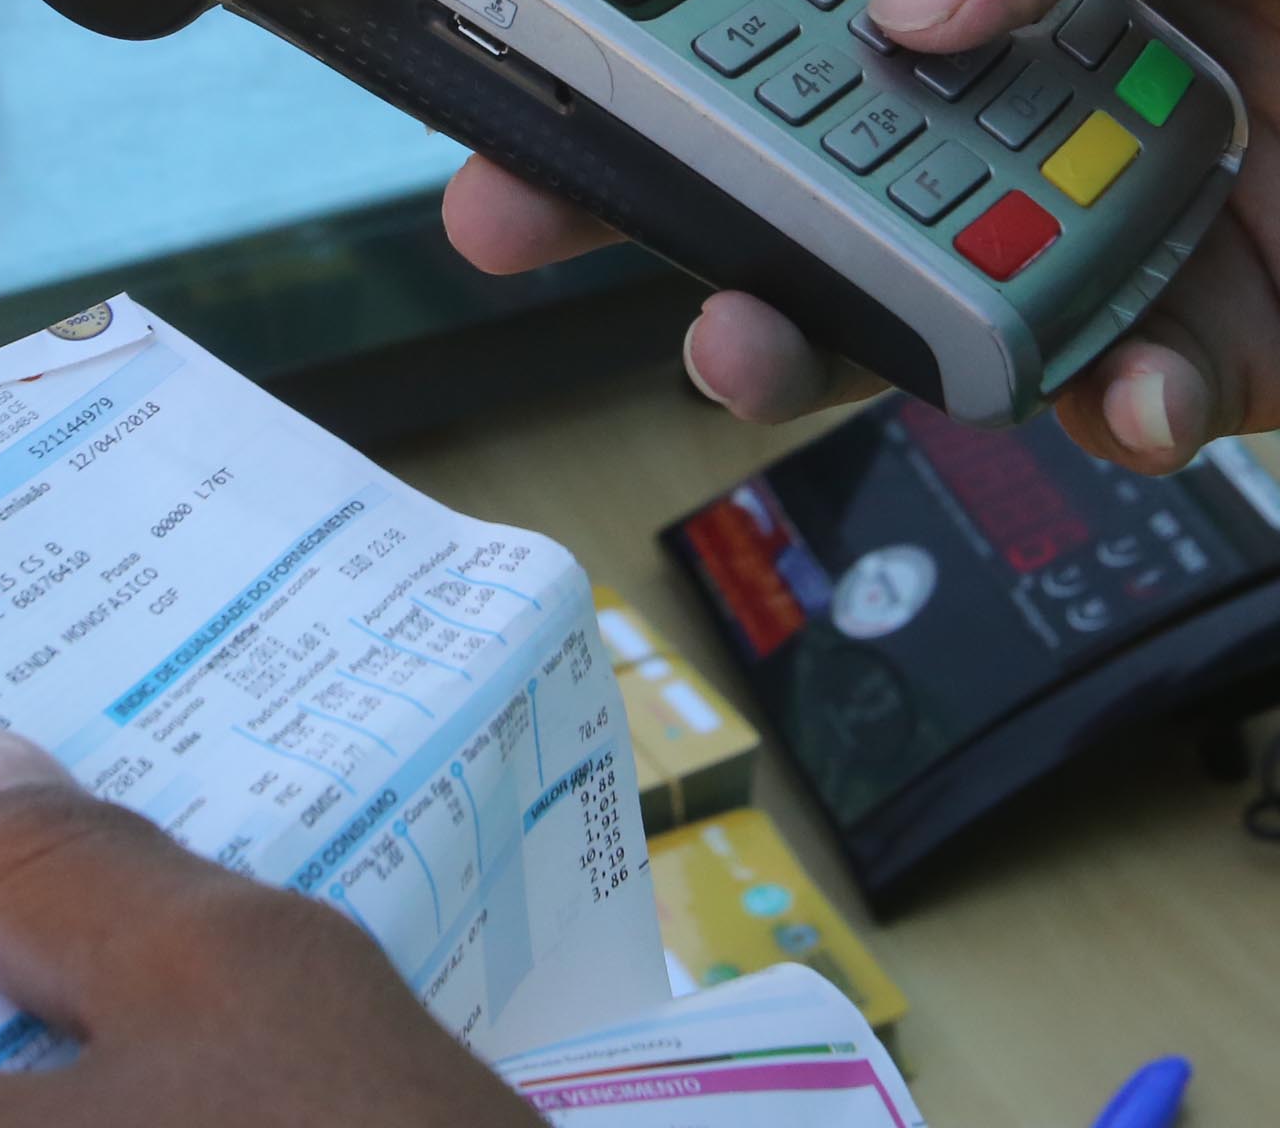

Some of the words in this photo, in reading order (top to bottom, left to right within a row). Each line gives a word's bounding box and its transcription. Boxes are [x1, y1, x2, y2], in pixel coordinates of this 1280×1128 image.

[726, 26, 755, 48] 1
[791, 72, 820, 98] 4
[850, 119, 881, 149] 7
[915, 170, 943, 201] F
[6, 399, 27, 414] CE
[29, 396, 115, 460] 521144979
[69, 402, 161, 472] 12/04/2018
[193, 466, 234, 499] L76T
[18, 554, 45, 574] CS
[43, 541, 63, 556] B
[148, 586, 178, 615] CGF
[153, 661, 179, 683] DE
[173, 597, 251, 665] QUALIDADE
[245, 579, 271, 602] DO
[267, 500, 364, 582] FORNECIMENTO
[5, 644, 59, 684] RENDA
[60, 567, 158, 643] MONOFASICO
[530, 781, 570, 821] VALOR
[580, 772, 616, 808] 9,88
[583, 790, 619, 826] 1,01
[298, 862, 327, 889] DO
[321, 789, 397, 866] CONSUMO
[586, 808, 620, 844] 1,91
[579, 830, 621, 870] 10,35
[589, 847, 625, 884] 2,19
[592, 867, 629, 904] 3,86
[565, 1078, 702, 1107] VENCIMENTO
